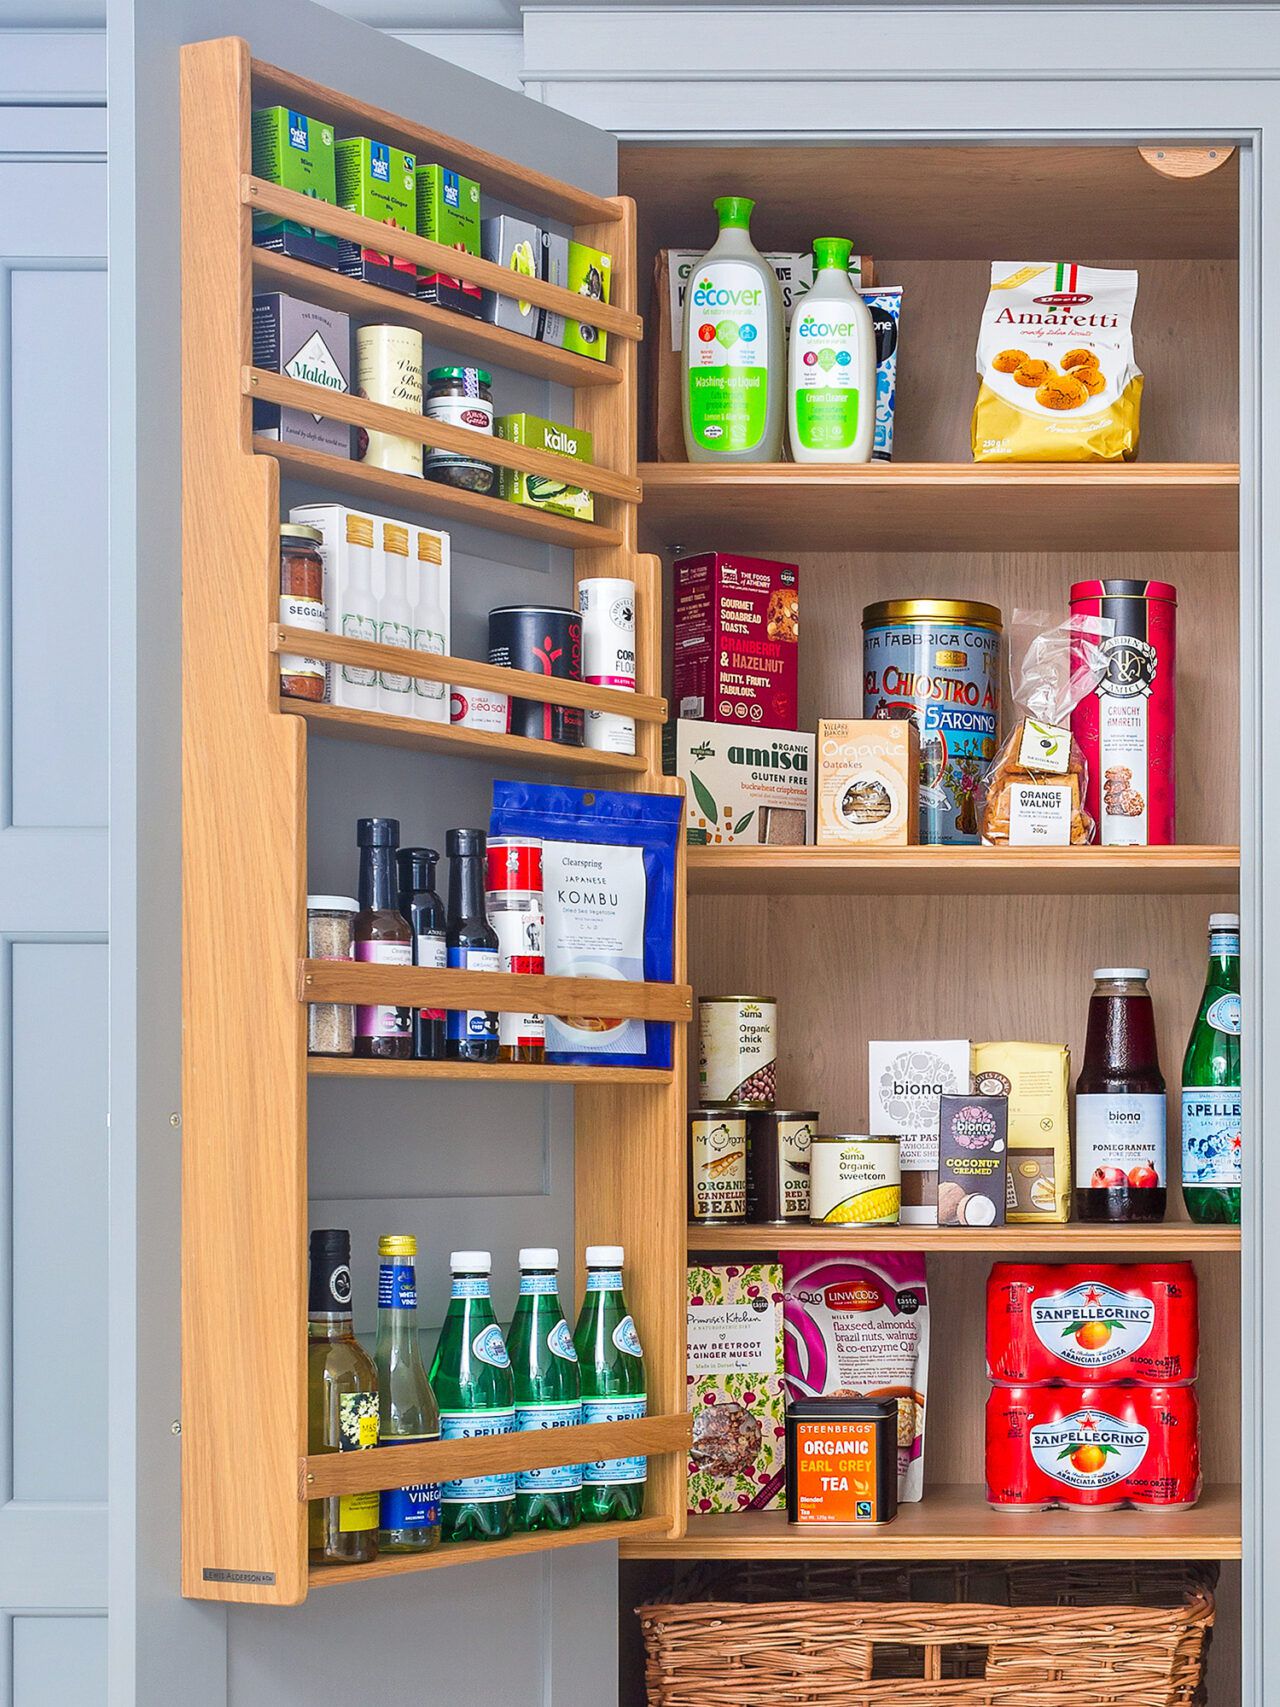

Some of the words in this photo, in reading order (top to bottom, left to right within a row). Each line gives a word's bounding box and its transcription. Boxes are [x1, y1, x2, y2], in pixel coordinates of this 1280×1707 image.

[694, 288, 762, 306] ecover
[994, 308, 1118, 328] Amaretti
[799, 322, 856, 337] ecover
[292, 362, 342, 390] Maldon
[695, 376, 738, 390] Washing-up
[738, 376, 760, 390] Liquid
[806, 394, 824, 402] Cream
[825, 394, 848, 402] Cleaner
[740, 572, 752, 582] THE
[720, 597, 754, 611] GOURMET
[720, 610, 762, 624] SODABREAD
[720, 622, 750, 635] TOASTS.
[568, 624, 580, 680] gravy
[720, 636, 780, 658] CRANBERRY
[720, 652, 729, 668] &
[732, 654, 784, 674] HAZELNUT
[720, 672, 744, 686] NUTTY.
[720, 685, 756, 698] FABULOUS.
[471, 703, 490, 712] sea
[1108, 706, 1140, 716] CRUNCHY
[1108, 718, 1141, 728] AMARETTI
[772, 742, 808, 754] ORGANIC
[822, 740, 906, 762] Organic
[728, 745, 808, 772] amisa
[822, 760, 863, 770] Oatcakes
[752, 772, 786, 784] GLUTEN
[790, 774, 808, 786] FREE
[740, 782, 774, 793] buckwheat
[775, 785, 808, 797] crispbread
[1020, 791, 1062, 800] ORANGE
[1020, 800, 1062, 808] WALNUT
[562, 856, 603, 870] Clearspring
[565, 876, 607, 886] JAPANESE
[558, 890, 618, 906] KOMBU
[740, 1010, 762, 1018] Suma
[740, 1024, 770, 1034] Organic
[740, 1034, 762, 1044] chick
[740, 1046, 760, 1054] peas
[894, 1081, 943, 1095] biona
[1109, 1110, 1141, 1122] biona
[957, 1120, 992, 1132] biona
[1092, 1144, 1156, 1152] POMEGRANATE
[840, 1152, 865, 1160] Suma
[840, 1162, 876, 1172] Organic
[946, 1158, 1000, 1168] COCONUT
[840, 1172, 886, 1181] sweetcorn
[828, 1290, 879, 1302] LINWOODS
[726, 1310, 762, 1323] Kitchen
[1036, 1308, 1150, 1320] SANPELLEGRINO
[833, 1322, 876, 1332] flaxseed,
[876, 1320, 917, 1331] almonds,
[836, 1331, 860, 1342] brazil
[862, 1332, 885, 1342] nuts,
[886, 1331, 918, 1341] walnuts
[688, 1342, 708, 1350] RAW
[712, 1341, 762, 1350] BEETROOT
[836, 1343, 845, 1352] &
[846, 1344, 898, 1354] co-enzyme
[694, 1352, 728, 1360] GINGER
[728, 1350, 762, 1358] MUESLI
[1061, 1350, 1101, 1364] ARANCIATA
[1102, 1348, 1127, 1362] ROSSA
[1130, 1357, 1153, 1366] BLOOD
[362, 1422, 377, 1433] M&S
[800, 1426, 870, 1434] STEENBERGS
[1034, 1432, 1144, 1446] SANPELLEGRINO
[804, 1440, 869, 1454] ORGANIC
[800, 1460, 833, 1472] EARL
[839, 1459, 872, 1473] GREY
[1056, 1470, 1097, 1484] ARANCIATA
[1097, 1471, 1121, 1484] ROSSA
[820, 1477, 849, 1492] TEA
